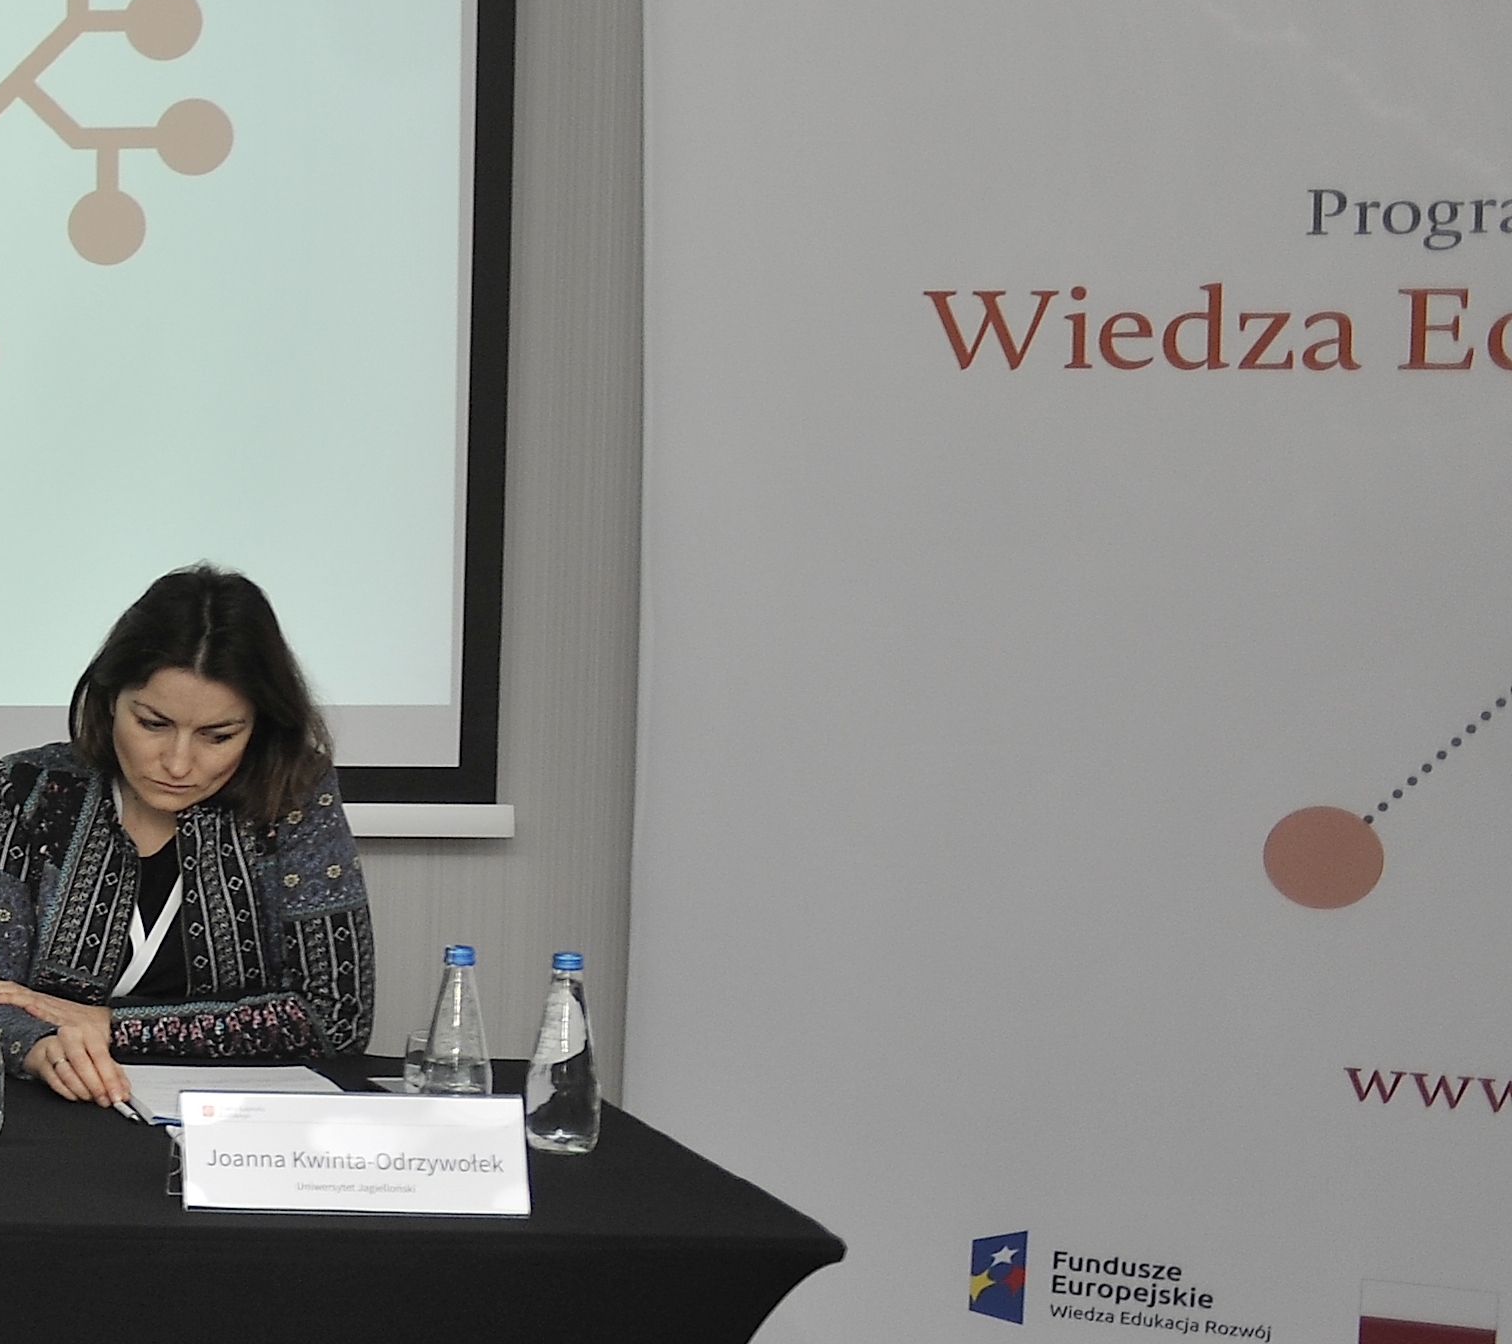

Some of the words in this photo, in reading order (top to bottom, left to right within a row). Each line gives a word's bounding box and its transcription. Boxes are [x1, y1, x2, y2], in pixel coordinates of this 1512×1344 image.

[922, 282, 1361, 372] Wiedza
[207, 1148, 286, 1169] Joanna
[293, 1151, 505, 1176] Kwinta-Odrzywołek
[297, 1182, 355, 1194] Uniwersytet
[1052, 1251, 1182, 1282] Fundusze
[1051, 1274, 1214, 1309] Europejskie
[1050, 1304, 1114, 1324] Wiedza
[1120, 1311, 1200, 1334] Edukacja
[1205, 1320, 1272, 1343] Rozwój
